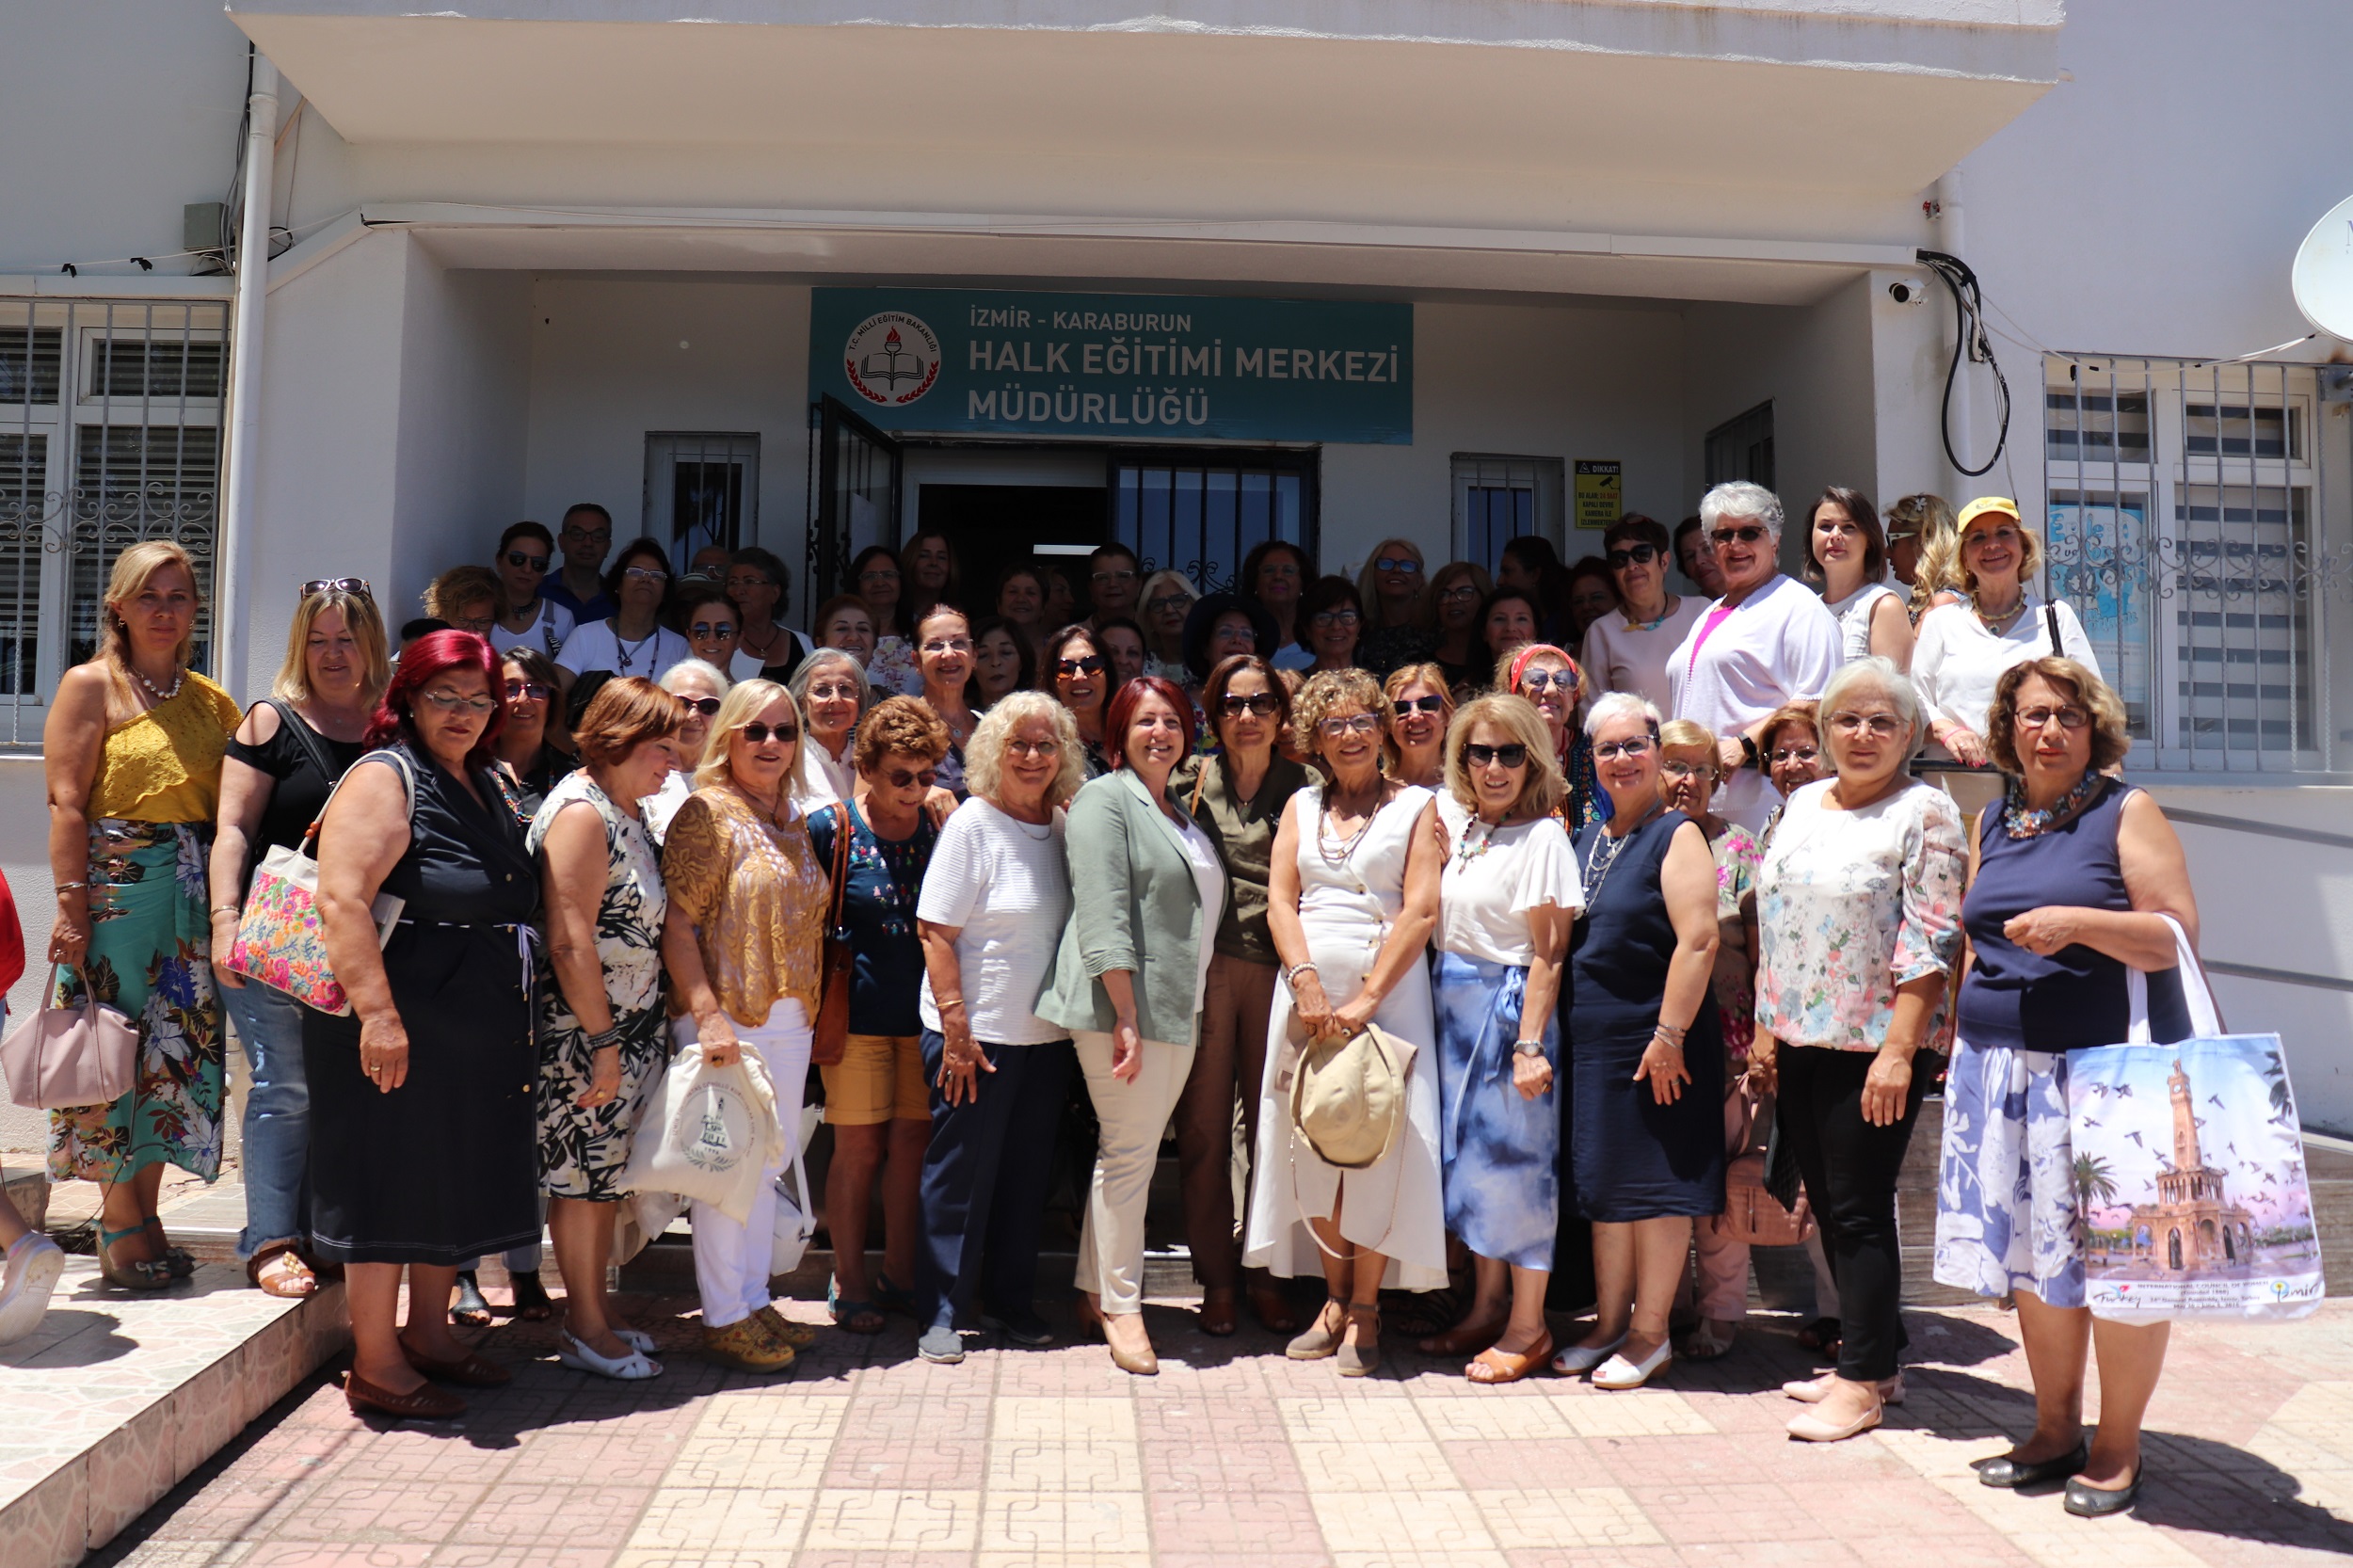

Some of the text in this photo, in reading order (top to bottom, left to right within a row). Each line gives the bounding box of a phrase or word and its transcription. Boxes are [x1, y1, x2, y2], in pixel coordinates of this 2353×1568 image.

[849, 314, 937, 352] T.C. MİLLİ EĞİTİM BAKANLIĞI
[969, 304, 1031, 328] İZMİR
[1053, 311, 1192, 333] KARABURUN
[968, 336, 1399, 384] HALK EĞİTİMİ MERKEZİ
[968, 382, 1209, 426] MÜDÜRLÜĞÜ
[1593, 464, 1619, 473] DİKKAT!
[2093, 1290, 2141, 1308] Turkey
[2196, 1281, 2230, 1289] COUNCIL
